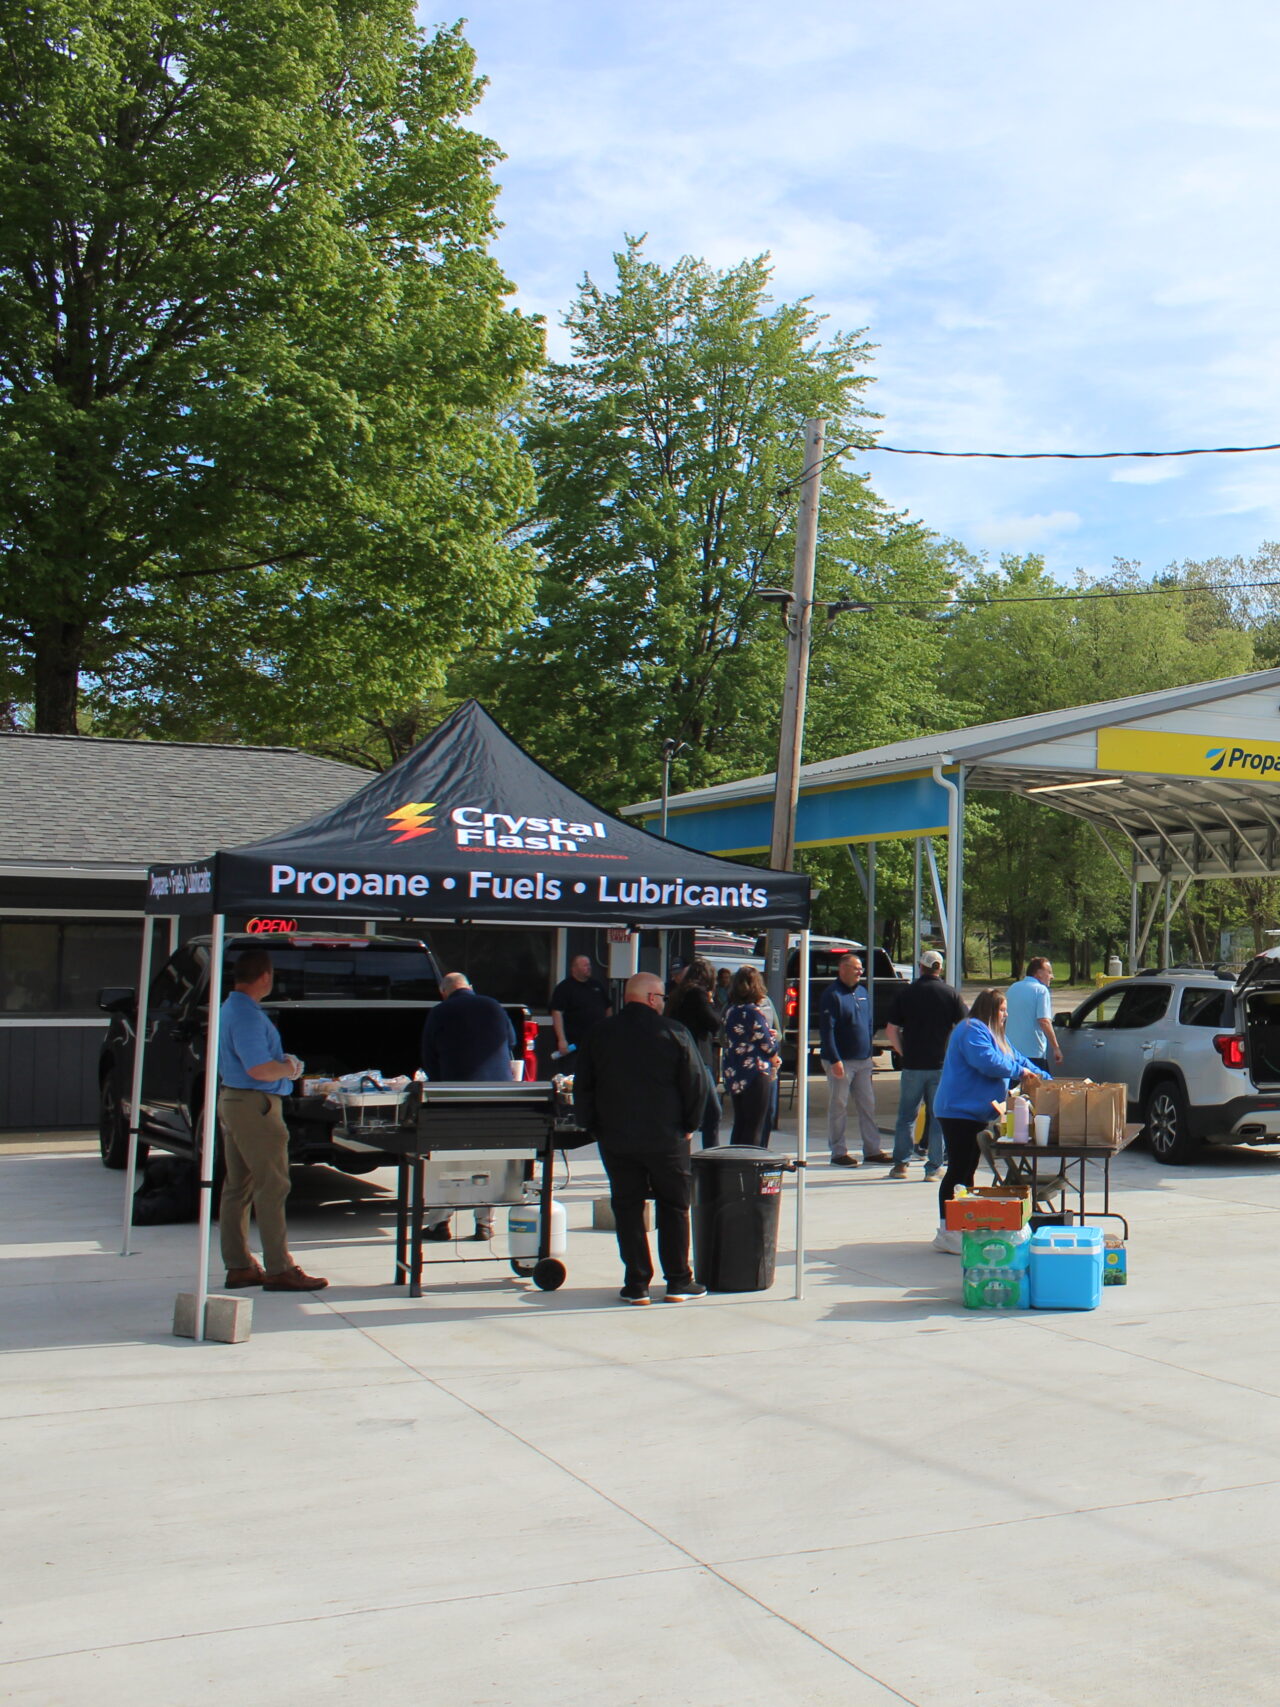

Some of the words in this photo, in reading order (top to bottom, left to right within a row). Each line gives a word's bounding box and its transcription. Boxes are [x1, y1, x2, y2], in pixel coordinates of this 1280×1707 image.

[452, 806, 607, 839] Crystal
[271, 864, 429, 901] Propane
[468, 870, 562, 900] Fuels
[599, 875, 768, 908] Lubricants
[249, 919, 293, 933] OPEN
